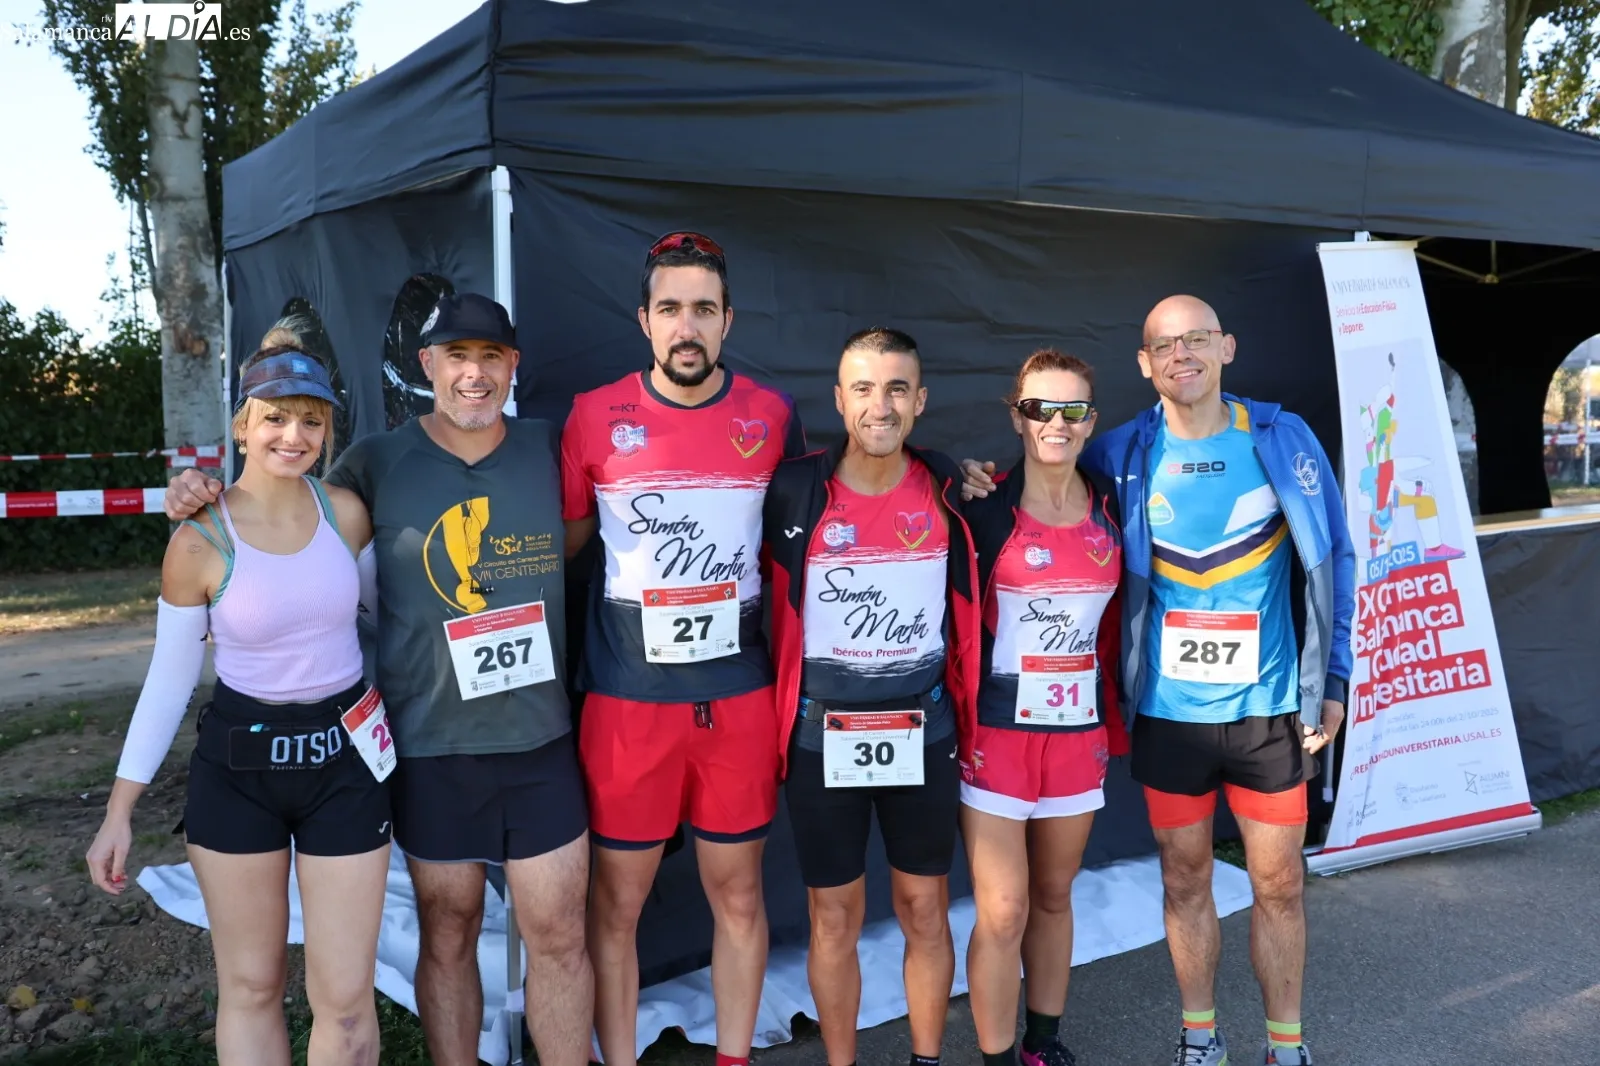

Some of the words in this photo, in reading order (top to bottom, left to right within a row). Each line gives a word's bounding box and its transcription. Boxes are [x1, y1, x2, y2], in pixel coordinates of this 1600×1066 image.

[111, 498, 138, 506] usal.es
[628, 492, 704, 540] Simón
[495, 561, 560, 580] CENTENARIO
[655, 536, 748, 582] Martín
[818, 566, 887, 607] Simón
[844, 604, 930, 644] Martín
[1020, 597, 1074, 627] Simón
[672, 614, 714, 643] 27
[473, 637, 533, 675] 267
[832, 647, 873, 658] Ibéricos
[876, 646, 917, 658] Premium
[1179, 639, 1242, 665] 287
[1046, 682, 1079, 707] 31
[270, 725, 343, 764] OTSO
[853, 741, 895, 767] 30
